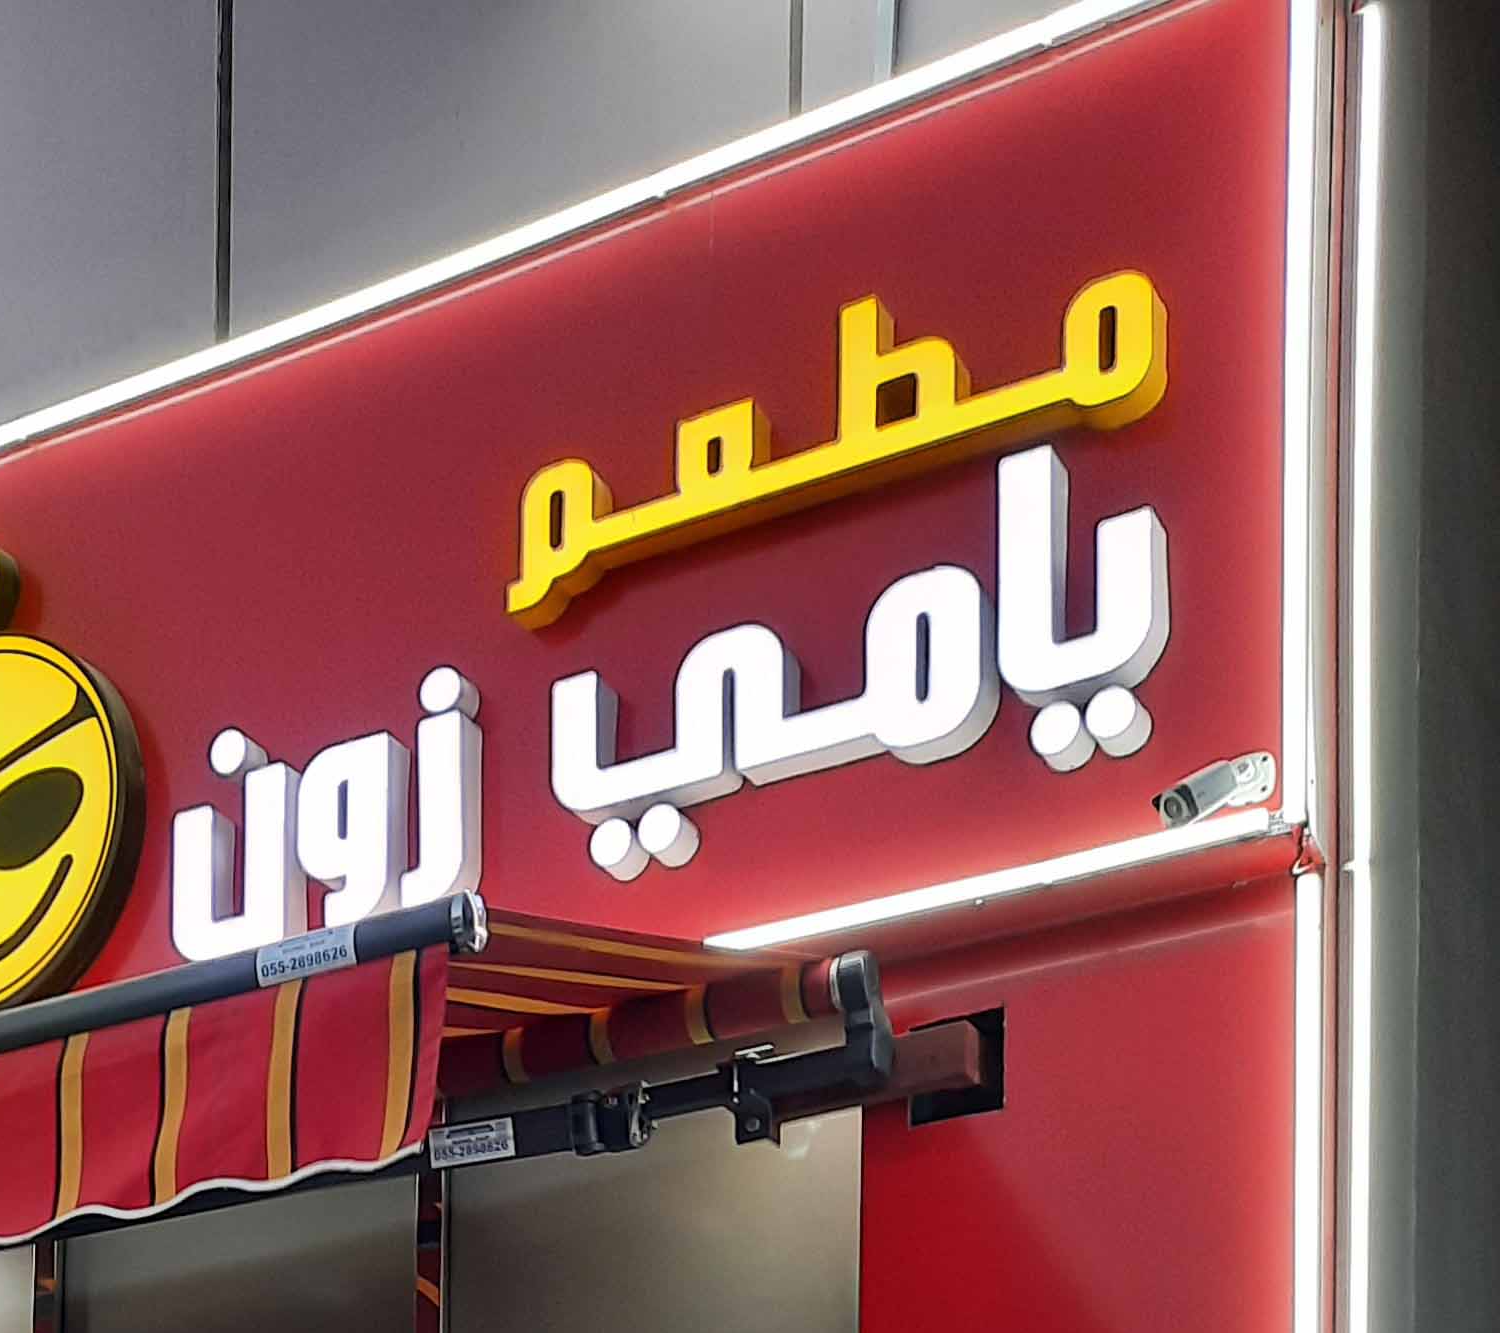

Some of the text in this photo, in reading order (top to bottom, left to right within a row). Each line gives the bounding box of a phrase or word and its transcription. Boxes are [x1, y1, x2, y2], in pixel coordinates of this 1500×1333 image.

[506, 268, 1169, 626] مطعم
[170, 444, 1171, 962] يامي زون
